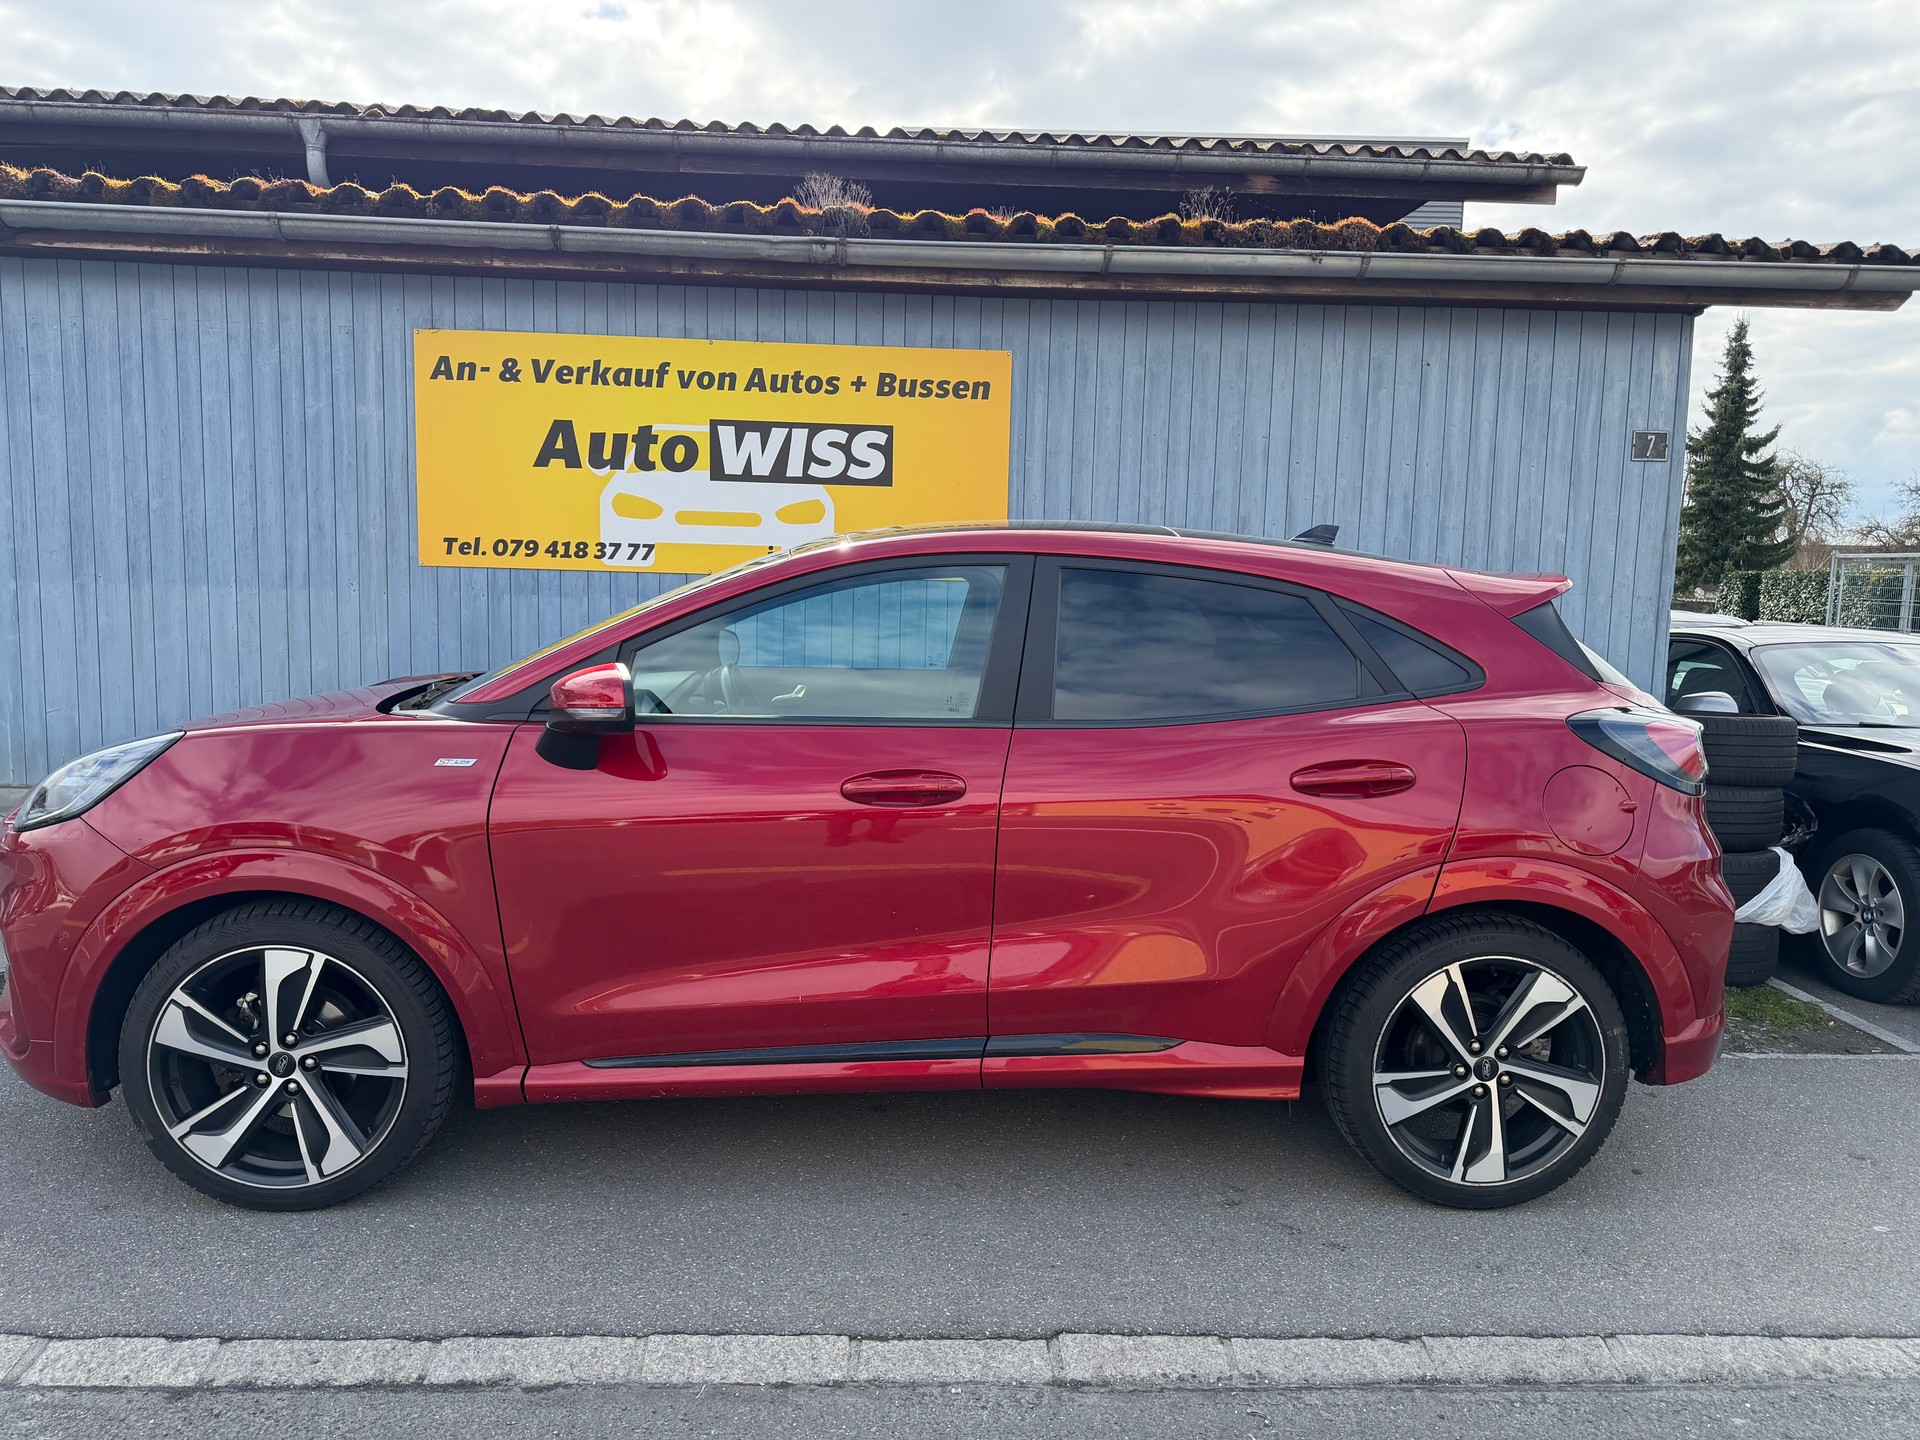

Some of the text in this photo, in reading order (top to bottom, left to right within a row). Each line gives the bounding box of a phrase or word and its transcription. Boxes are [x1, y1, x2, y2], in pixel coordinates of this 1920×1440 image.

[430, 355, 991, 401] An- & Verkauf von Autos + Bussen
[532, 419, 889, 480] Auto WISS
[1646, 435, 1656, 457] 7
[442, 536, 656, 561] Tel. 079 418 37 77
